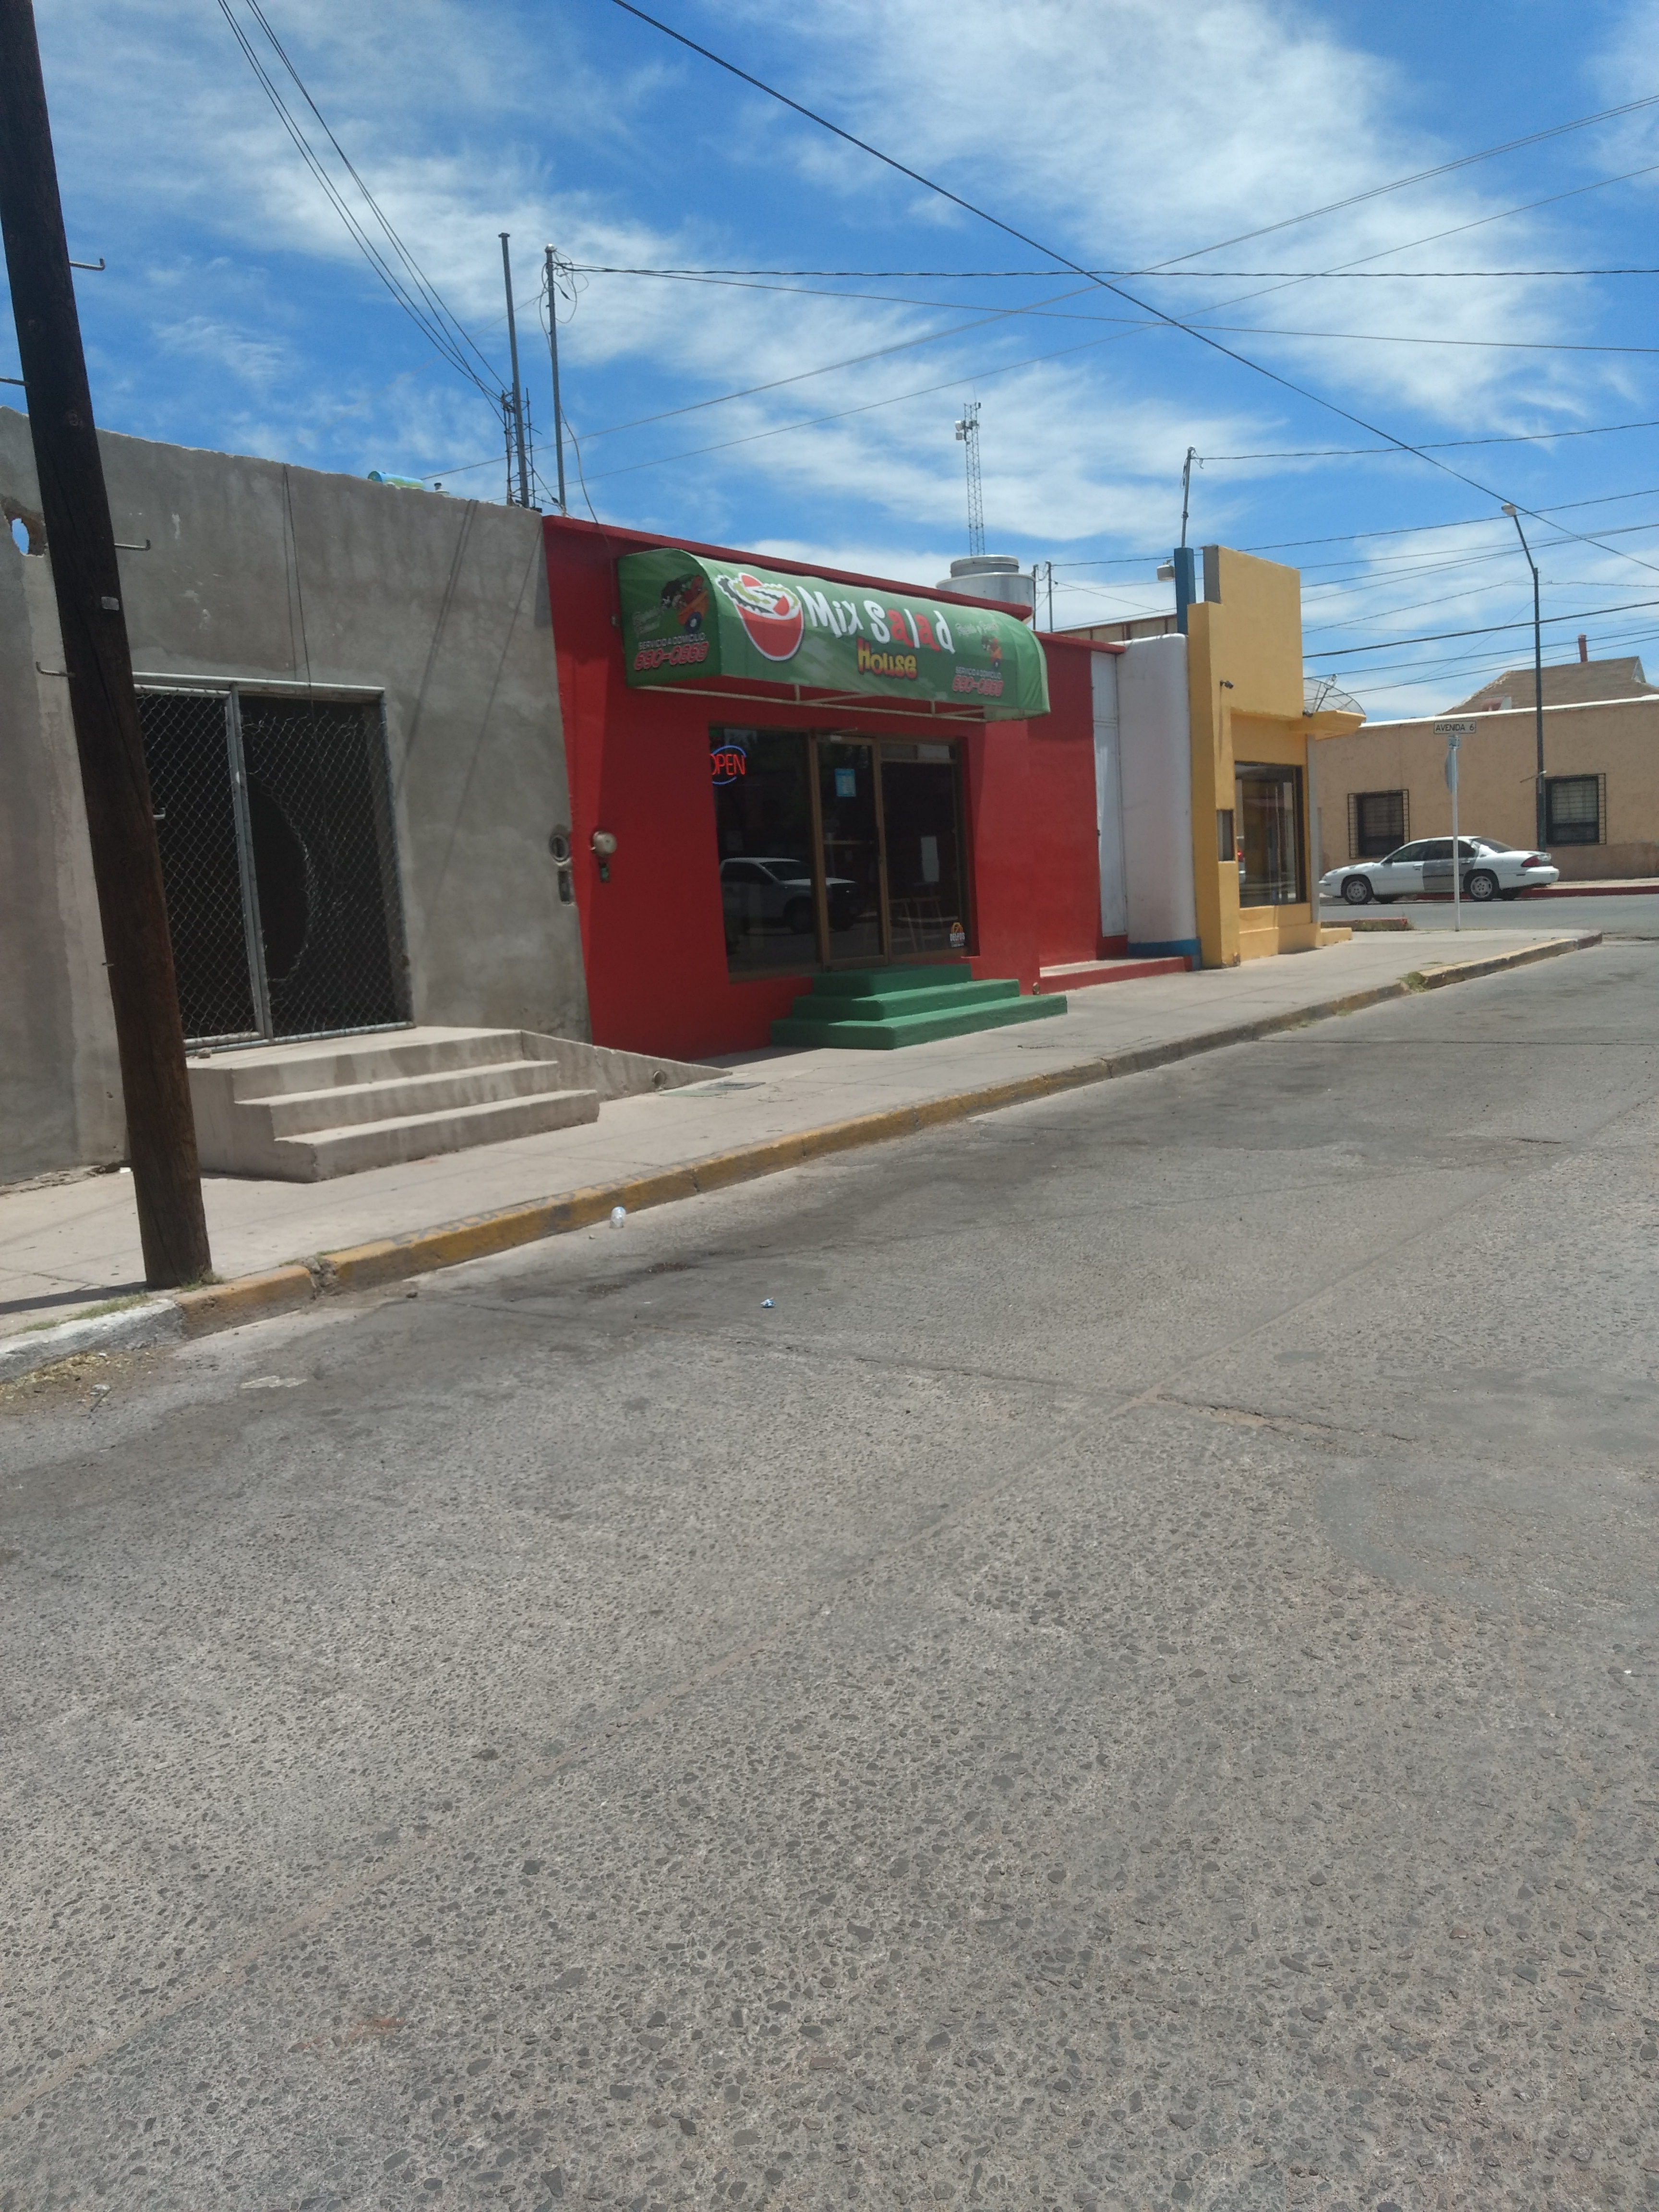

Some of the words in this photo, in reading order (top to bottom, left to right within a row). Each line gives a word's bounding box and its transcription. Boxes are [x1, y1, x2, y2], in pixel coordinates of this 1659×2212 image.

[795, 586, 864, 639] Mix
[864, 600, 955, 654] Salad
[638, 638, 667, 649] SERVICIO
[857, 637, 917, 679] House
